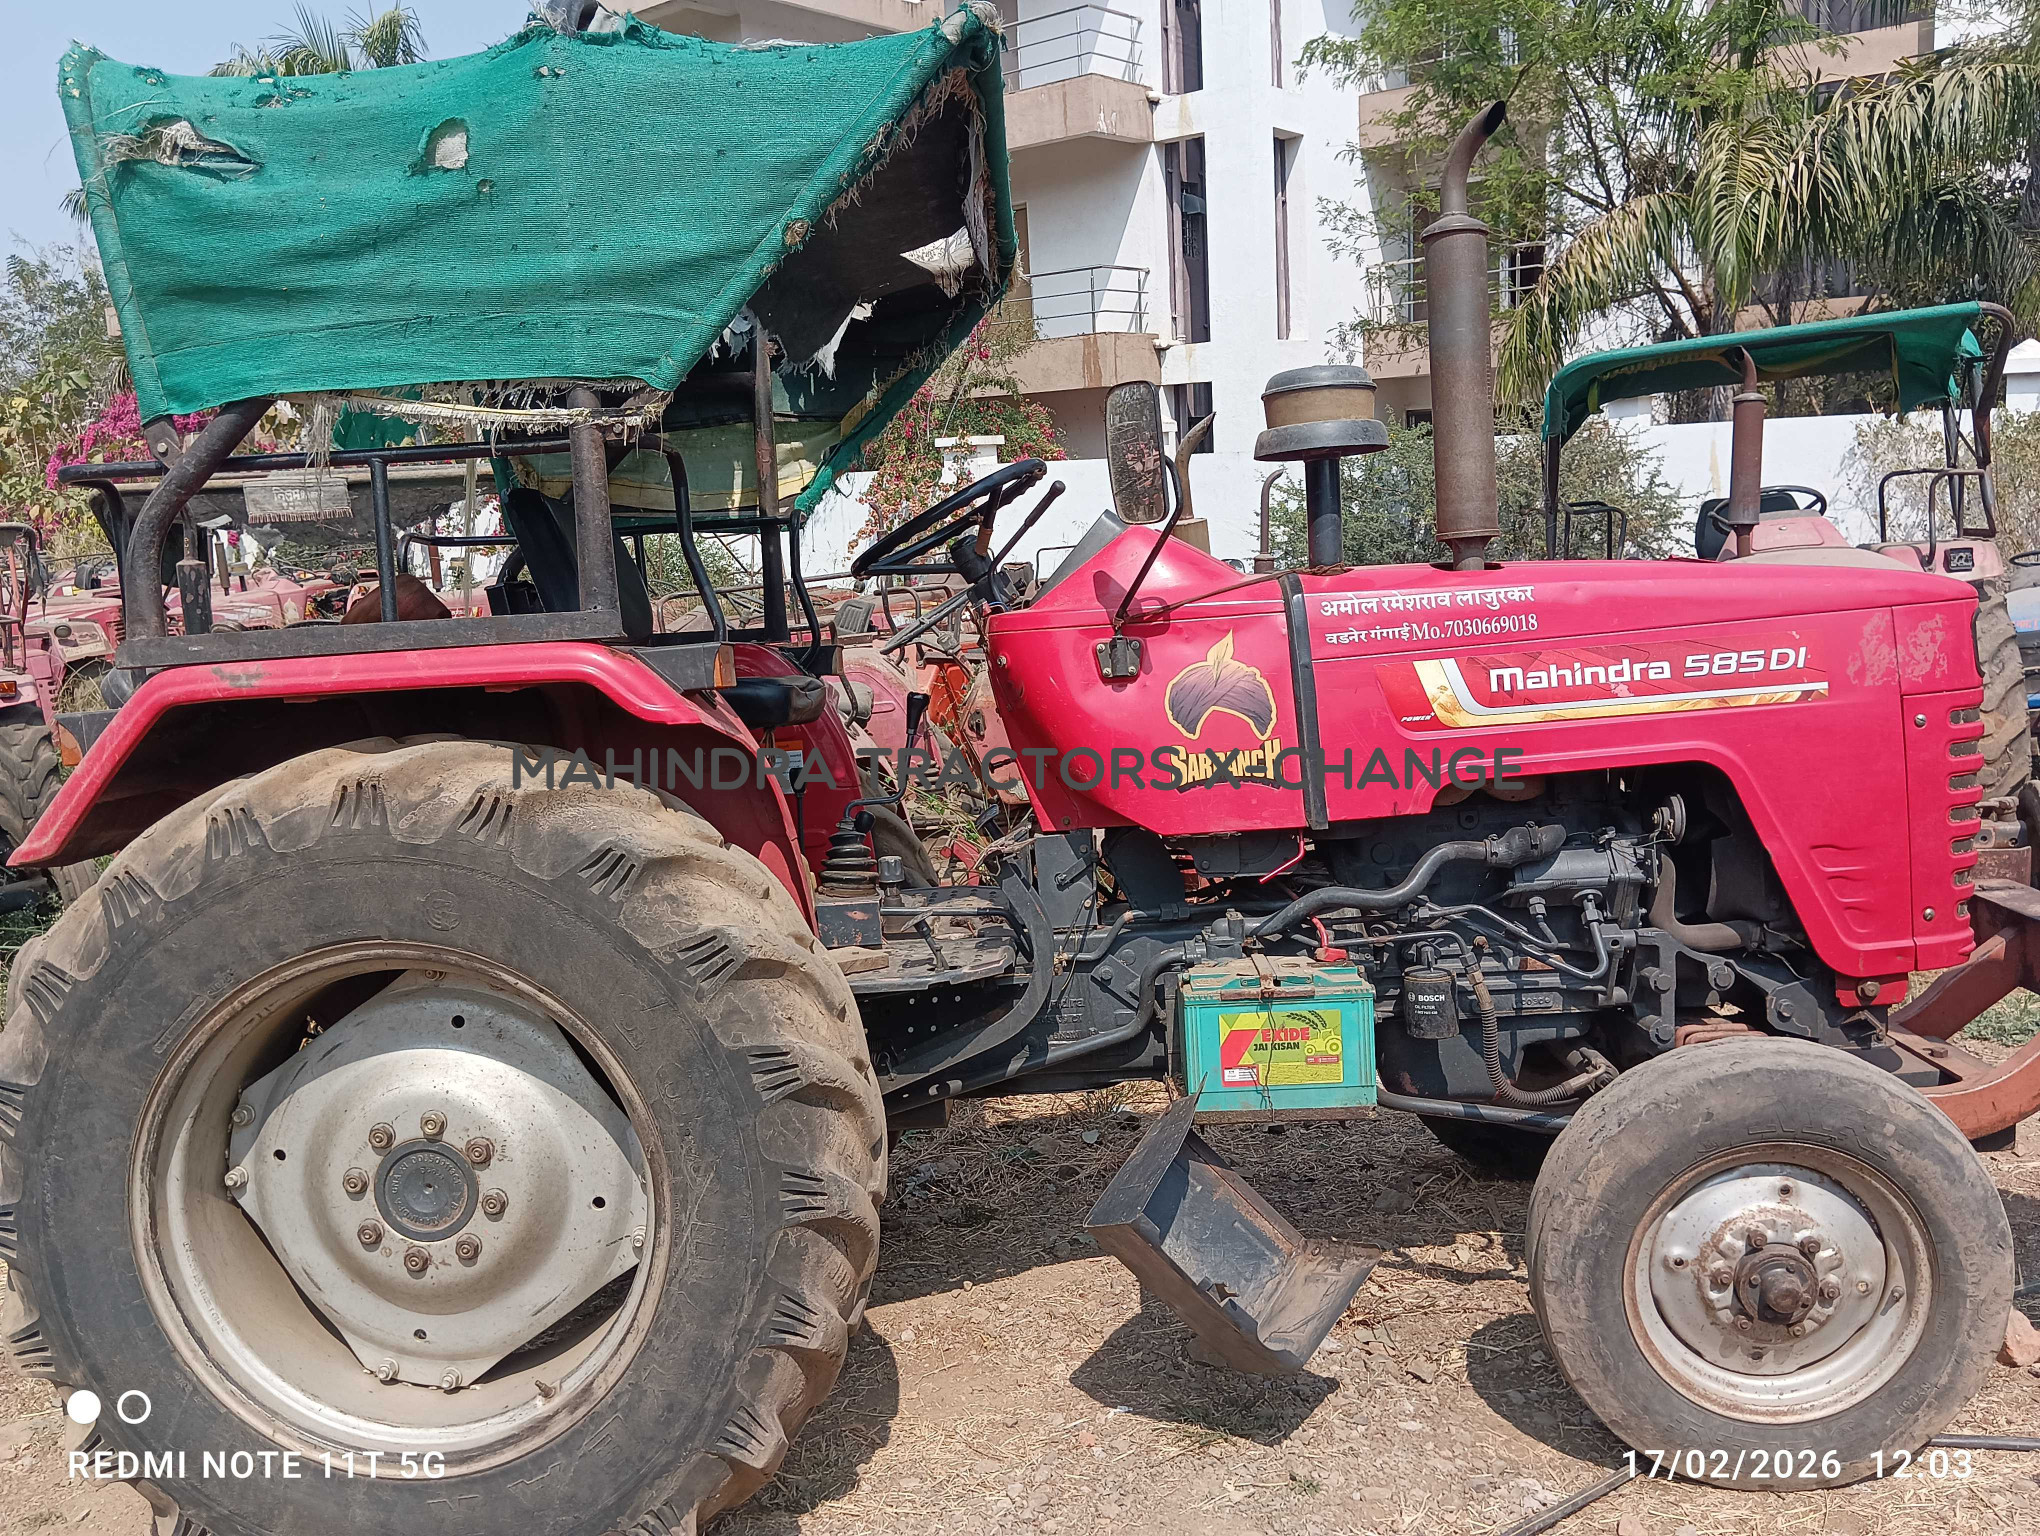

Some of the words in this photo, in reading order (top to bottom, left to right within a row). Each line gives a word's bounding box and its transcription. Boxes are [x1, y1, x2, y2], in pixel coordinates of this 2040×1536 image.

[1320, 593, 1378, 617] अमोल
[1382, 590, 1452, 613] रमेशराव
[1454, 586, 1535, 611] लाजुरकर
[1489, 657, 1671, 693] Mahindra
[1418, 994, 1446, 1002] BOSCH
[1261, 1027, 1311, 1042] EXIDE
[1253, 1043, 1268, 1052] JAI
[1271, 1042, 1300, 1051] KISAN
